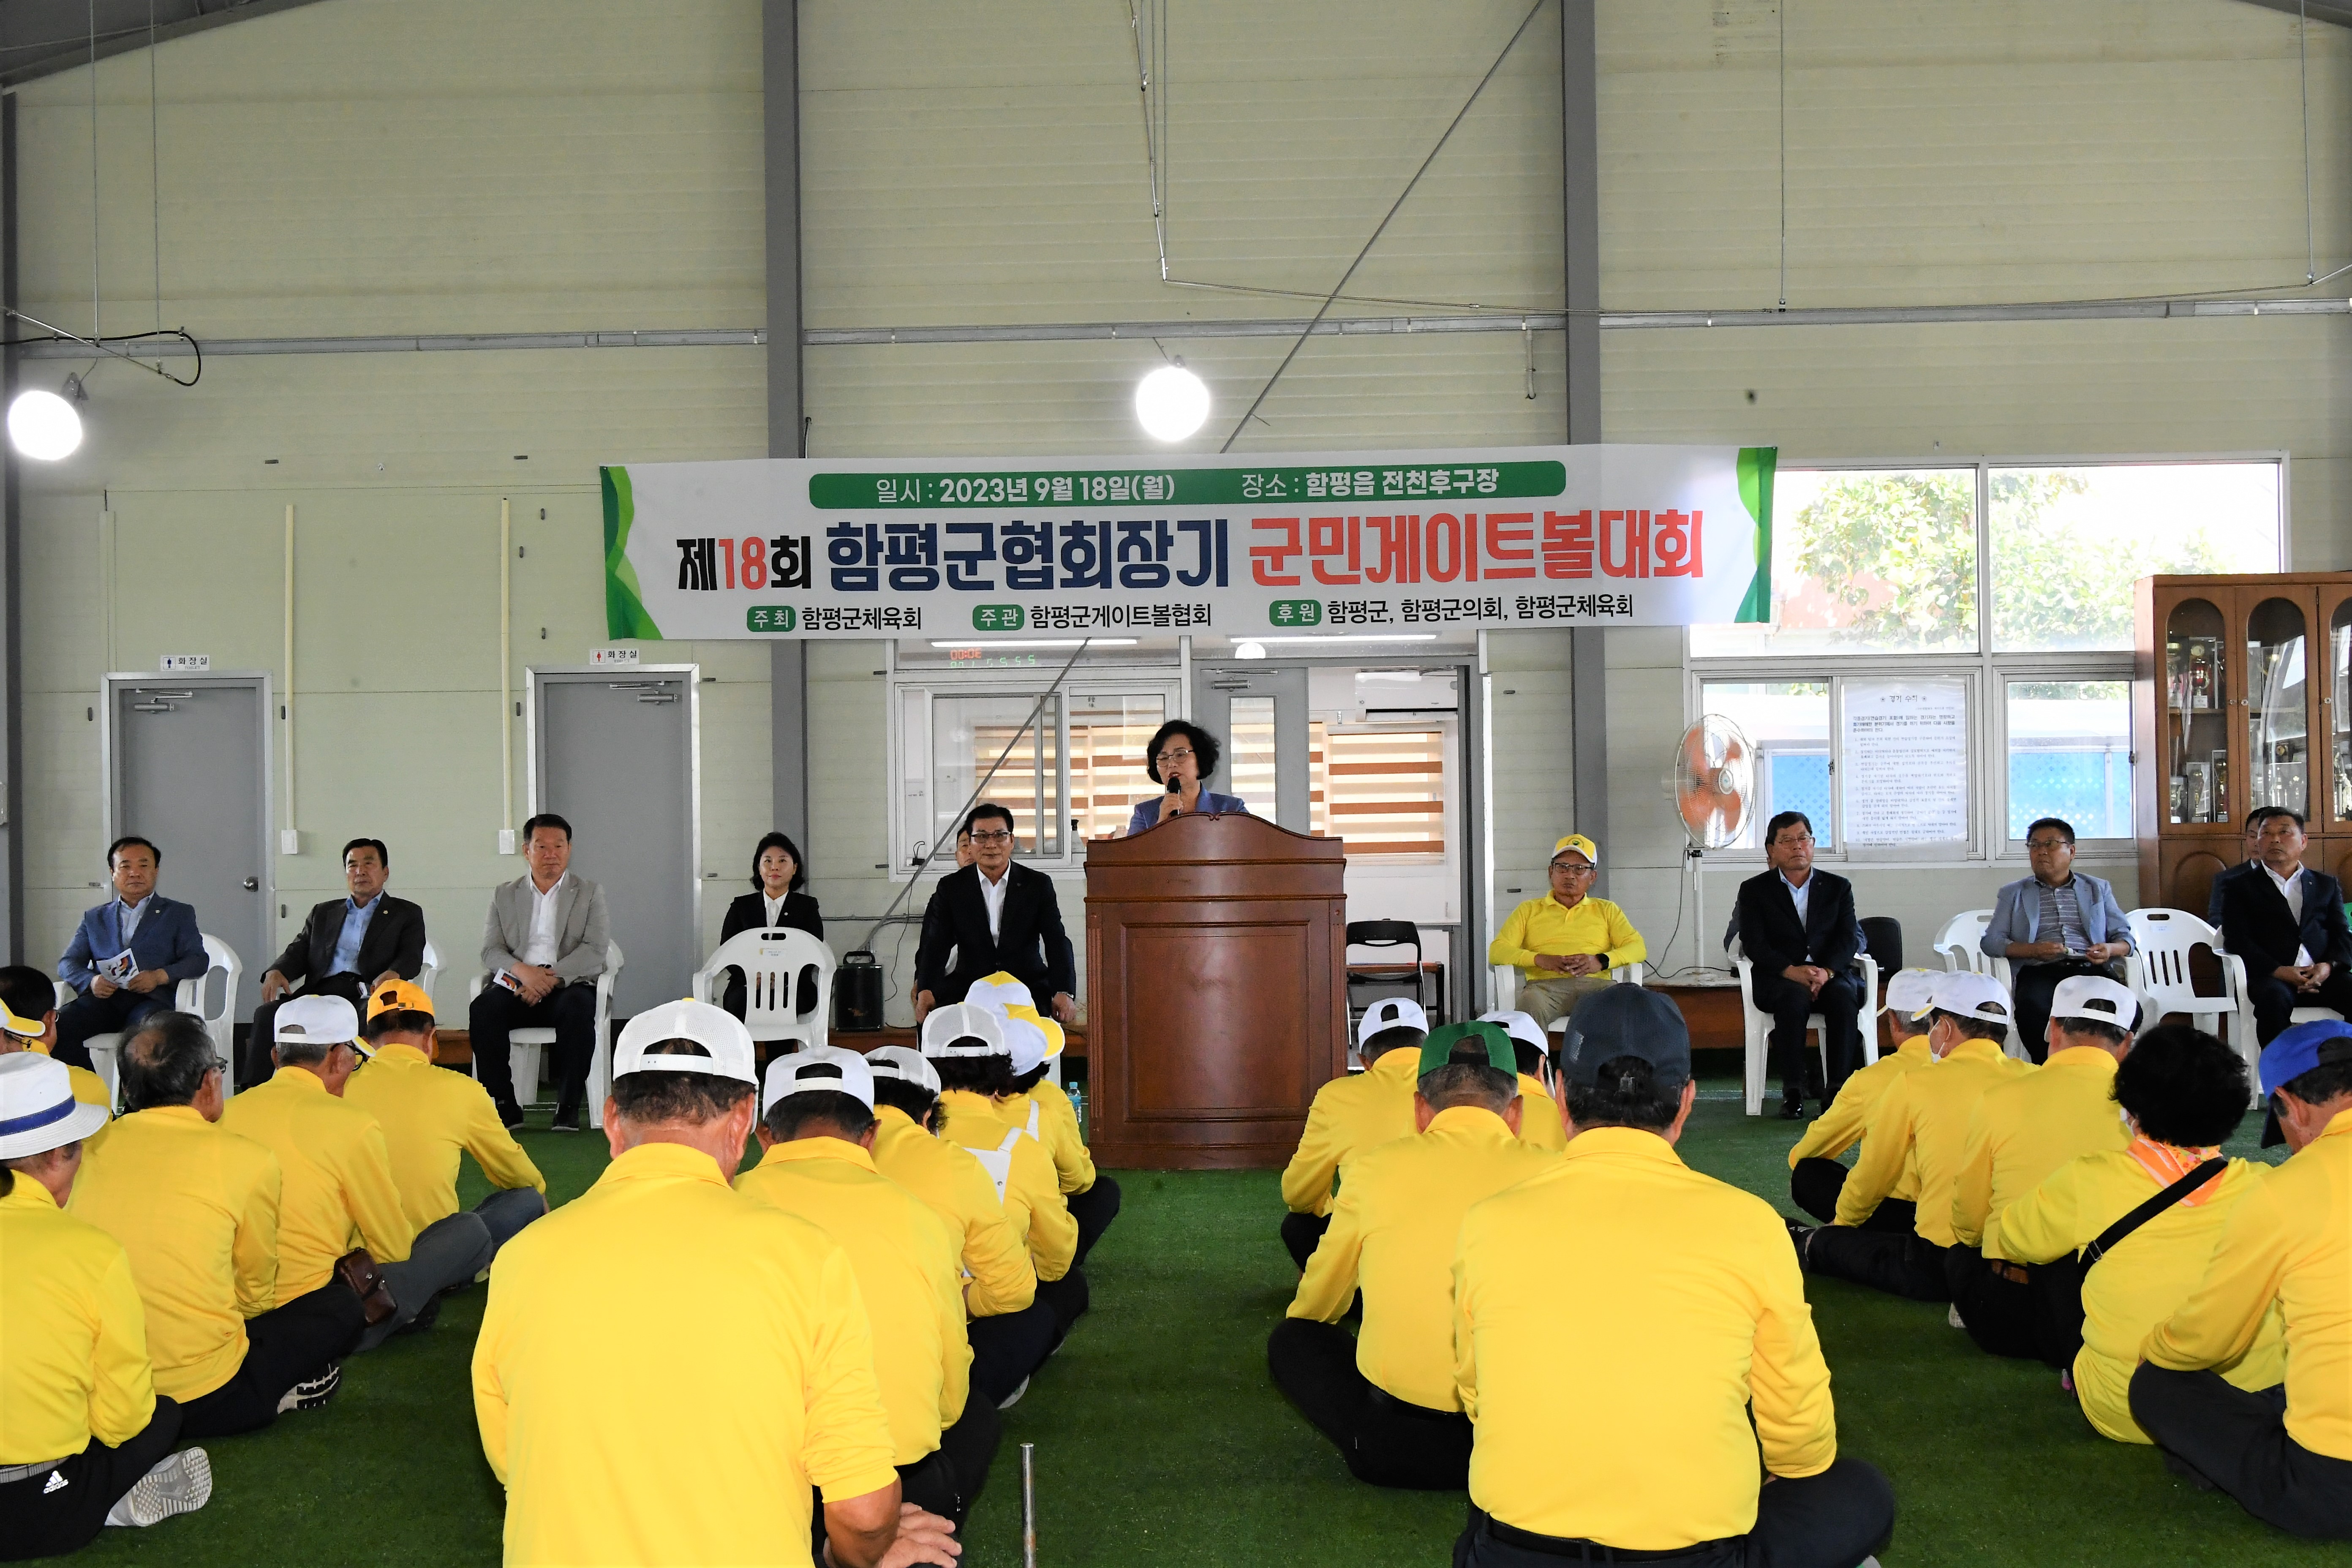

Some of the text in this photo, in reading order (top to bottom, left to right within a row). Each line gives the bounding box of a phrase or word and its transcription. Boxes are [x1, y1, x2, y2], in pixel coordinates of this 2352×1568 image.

[877, 479, 920, 502] 일시
[940, 478, 1027, 502] 2023년
[1034, 477, 1073, 501] 9월
[1080, 475, 1174, 500] 18일(월)
[1243, 474, 1286, 497] 장소
[1306, 471, 1375, 496] 함평읍
[1383, 469, 1499, 495] 전천후구장
[677, 509, 1703, 591] 제18회 함평군협회장기 군민게이트볼대회
[802, 607, 920, 630] 함평군체육회
[1031, 604, 1211, 629] 함평군게이트볼협회
[1328, 601, 1393, 623] 함평군,
[1401, 597, 1508, 622] 함평군의회,
[1516, 594, 1632, 618] 함평군체육회
